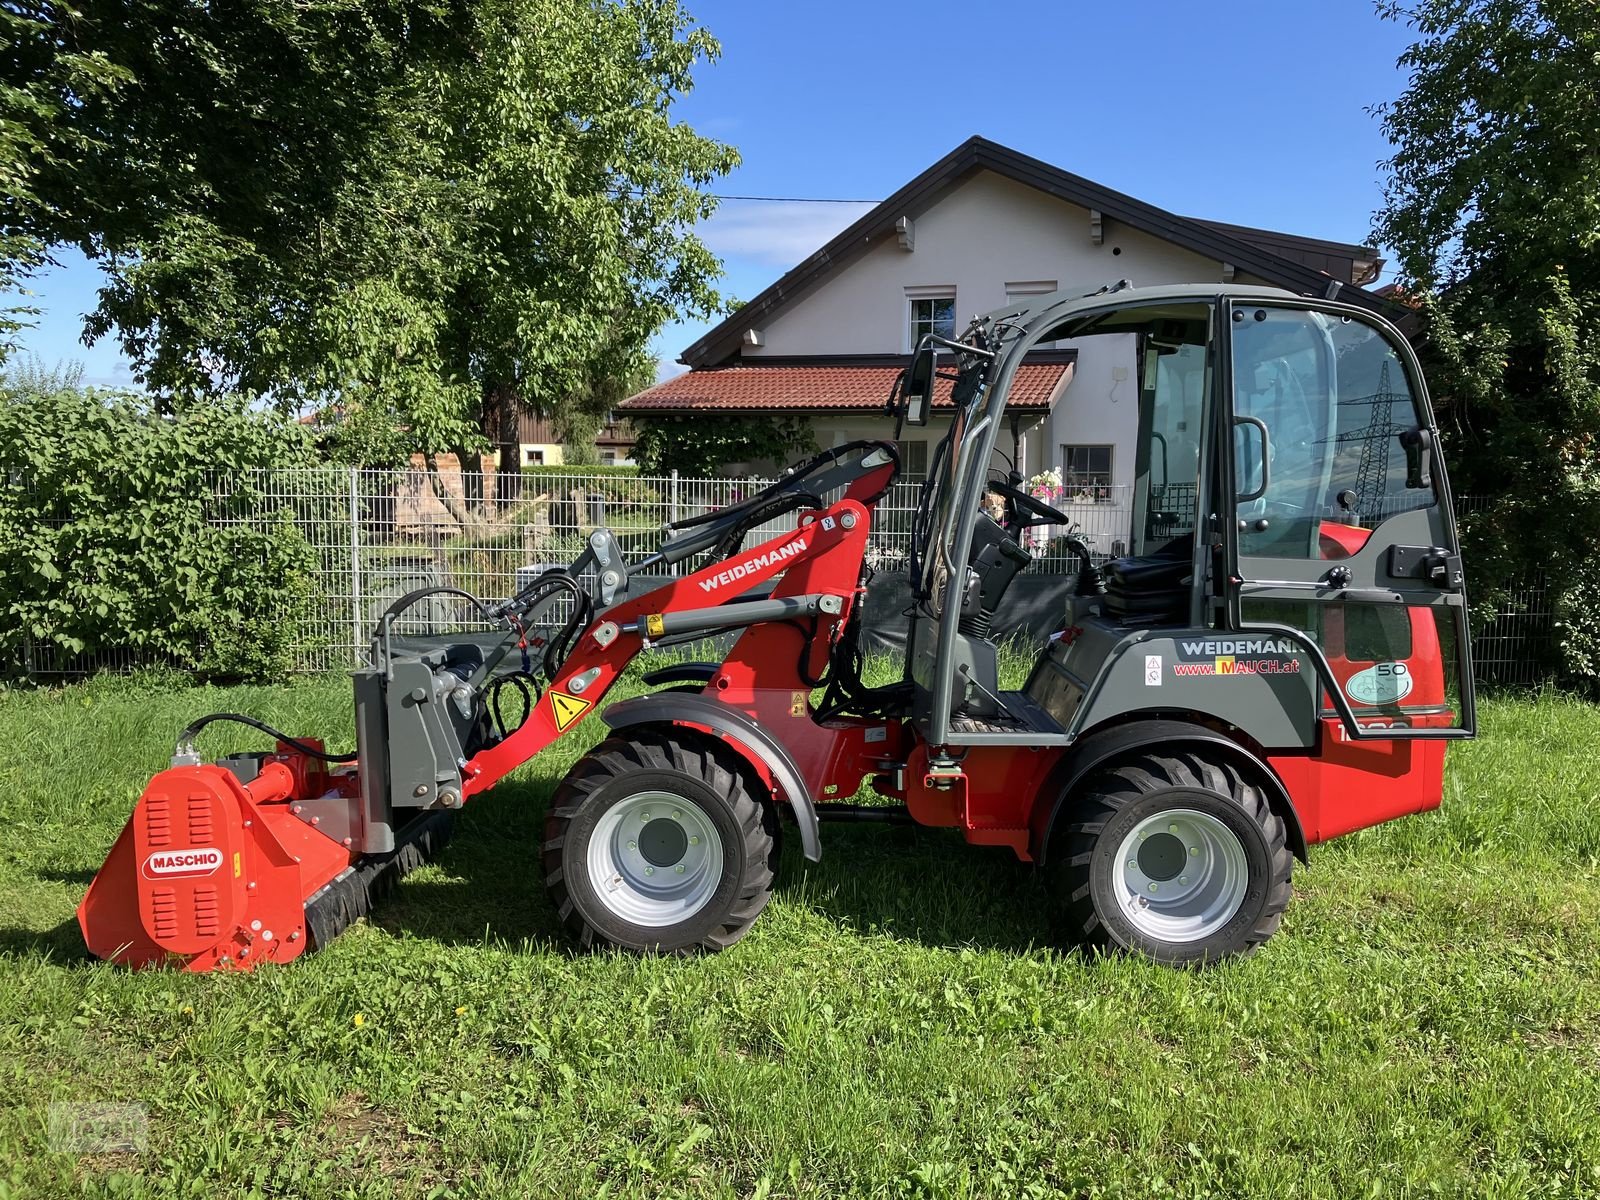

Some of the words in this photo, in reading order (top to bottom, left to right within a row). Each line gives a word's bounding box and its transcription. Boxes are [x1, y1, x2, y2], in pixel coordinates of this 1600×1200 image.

[698, 539, 807, 592] WEIDEMANN
[1174, 659, 1299, 675] www.MAUCH.at
[1378, 664, 1406, 676] 50
[153, 853, 218, 868] MASCHIO
